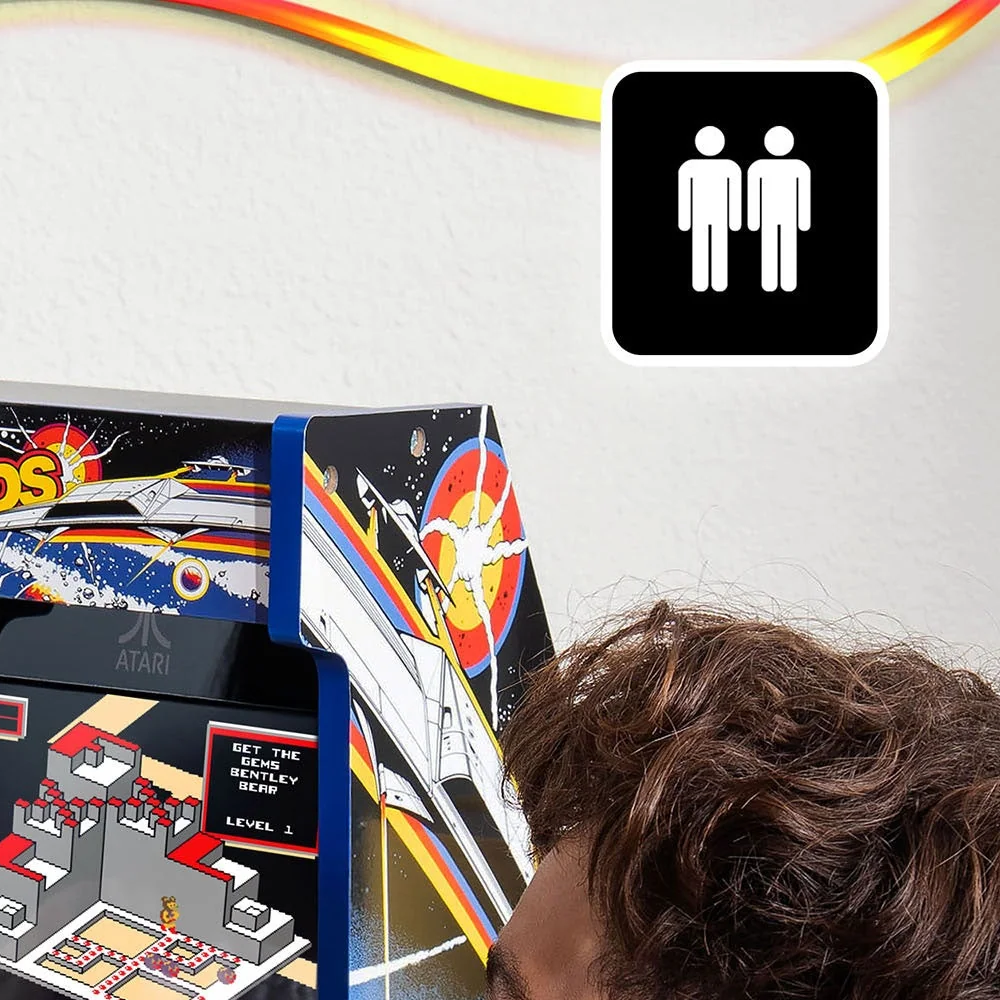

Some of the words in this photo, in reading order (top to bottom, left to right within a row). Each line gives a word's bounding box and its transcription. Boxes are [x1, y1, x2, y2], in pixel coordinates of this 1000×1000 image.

[115, 648, 170, 675] ATARI
[232, 742, 262, 755] GET
[272, 747, 301, 761] THE
[241, 756, 280, 770] GEMS
[230, 767, 299, 785] BENTLEY
[239, 781, 278, 795] BEAR
[226, 816, 274, 832] LEVEL
[284, 825, 294, 835] 1
